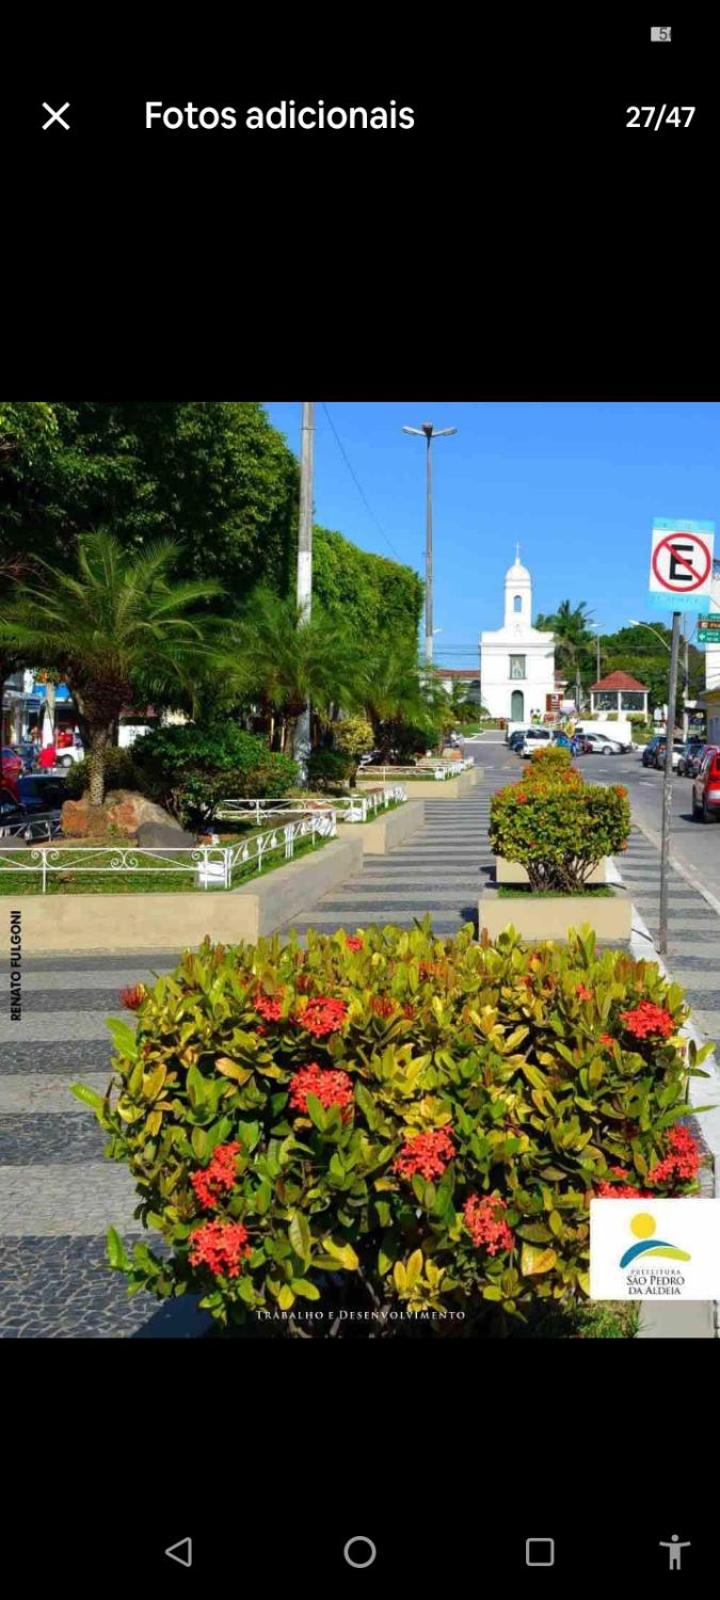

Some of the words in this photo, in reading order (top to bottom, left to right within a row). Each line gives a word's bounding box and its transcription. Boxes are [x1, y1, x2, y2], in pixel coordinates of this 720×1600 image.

[145, 100, 237, 129] Fotos
[245, 100, 415, 129] adicionais
[626, 103, 696, 131] 27/47
[669, 544, 694, 581] E
